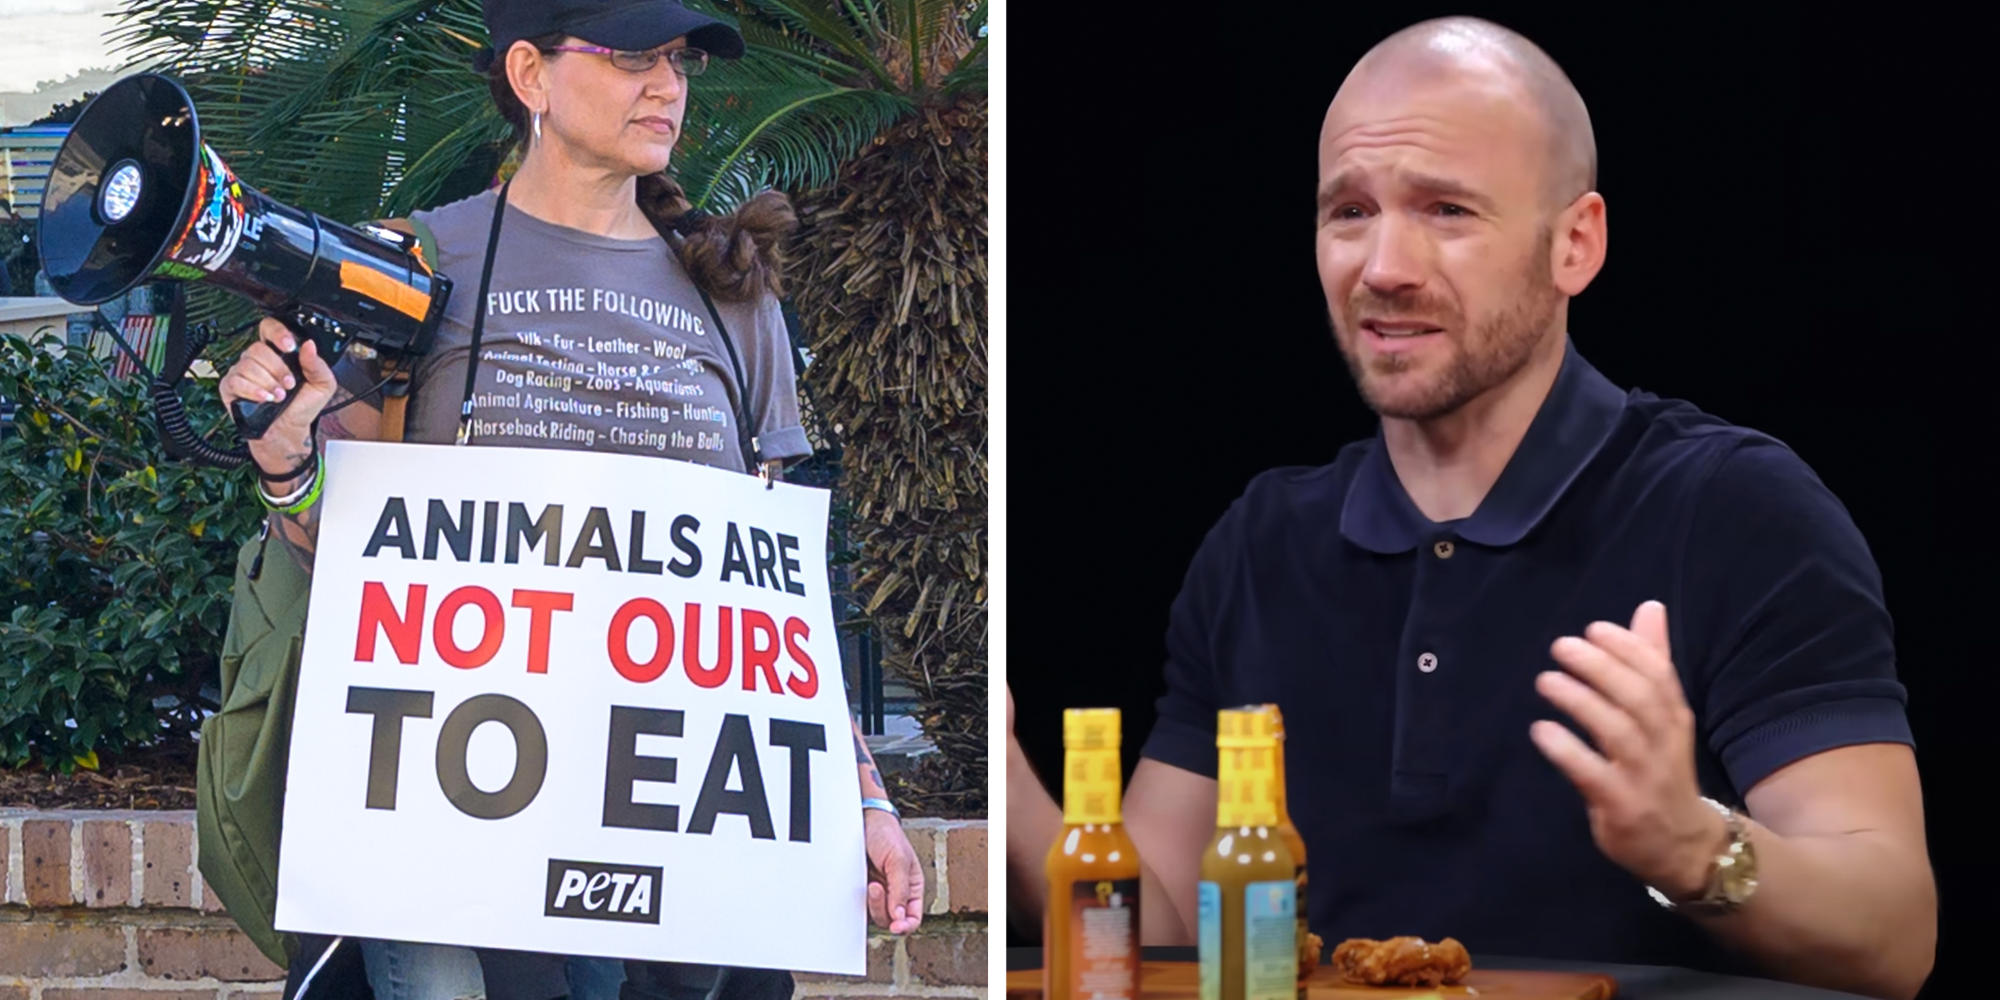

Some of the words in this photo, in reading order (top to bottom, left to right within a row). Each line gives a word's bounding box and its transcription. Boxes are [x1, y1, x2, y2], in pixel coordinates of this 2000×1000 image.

[487, 290, 541, 316] FUCK
[545, 288, 586, 312] THE
[593, 288, 705, 336] FOLLOWING
[554, 333, 575, 350] Fur
[588, 336, 640, 354] Leather
[653, 340, 687, 360] Wool
[484, 351, 533, 362] Animal
[597, 362, 637, 377] Horse
[496, 369, 523, 388] Dog
[526, 370, 572, 392] Racing
[586, 376, 621, 391] Zoos
[635, 377, 704, 396] Aquariums
[524, 393, 602, 417] Agriculture
[617, 401, 669, 422] Fishing
[683, 403, 727, 427] Hunting
[473, 418, 548, 438] Horseback
[550, 421, 595, 446] Riding
[610, 426, 667, 450] Chasing
[671, 429, 694, 448] the
[697, 431, 724, 451] Bulls
[362, 496, 702, 578] ANIMALS
[720, 521, 806, 597] ARE
[353, 580, 574, 674] NOT
[607, 597, 819, 699] OURS
[345, 685, 549, 820] TO
[601, 704, 827, 843] EAT
